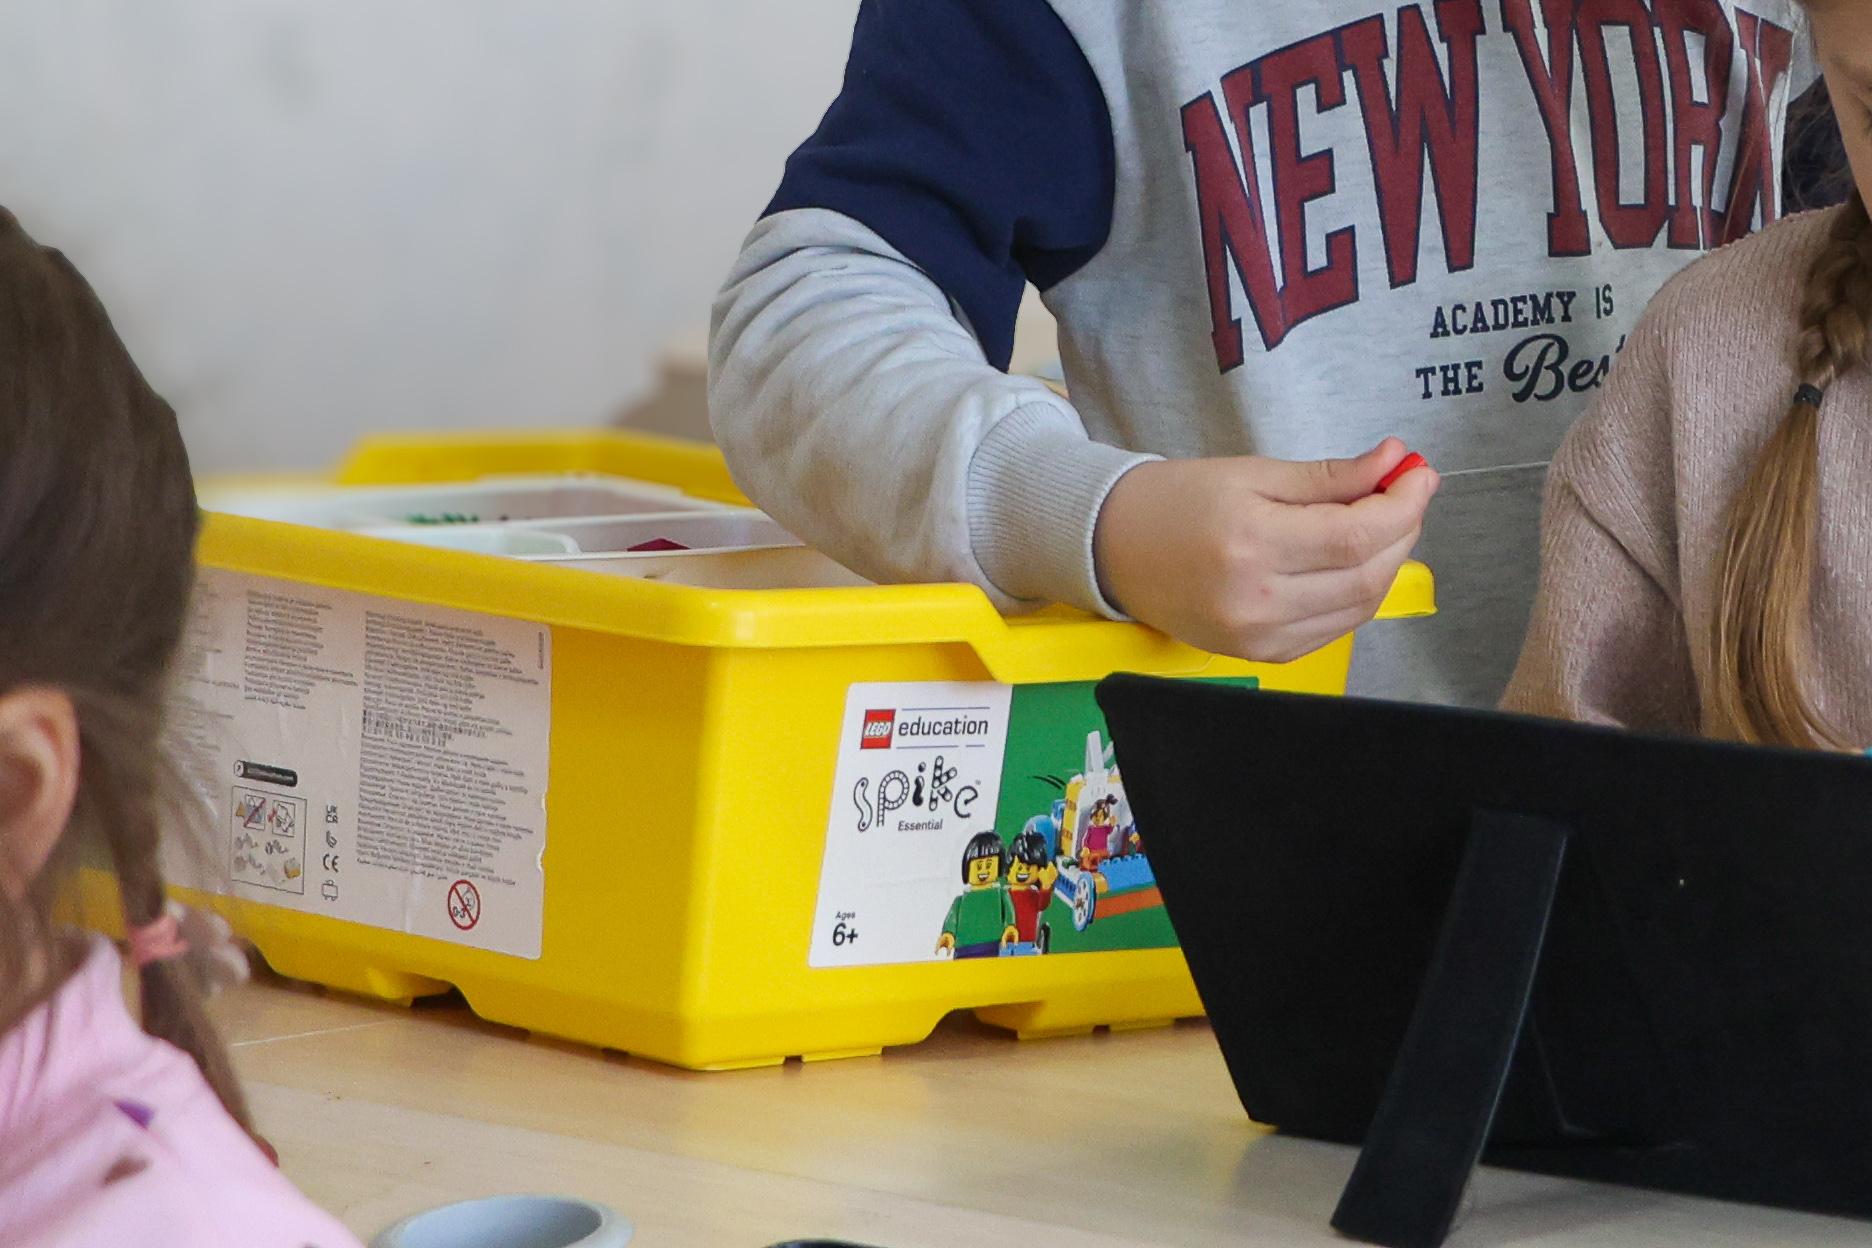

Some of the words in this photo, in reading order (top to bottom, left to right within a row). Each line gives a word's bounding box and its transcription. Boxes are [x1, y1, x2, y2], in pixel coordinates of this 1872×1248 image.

[1429, 291, 1577, 339] ACADEMY
[1595, 283, 1614, 319] IS
[1415, 360, 1484, 400] THE
[1503, 333, 1626, 403] Bes
[898, 715, 989, 737] education
[897, 818, 943, 832] Essential
[323, 853, 339, 873] CE
[835, 911, 856, 921] Ages
[832, 922, 859, 947] 6+
